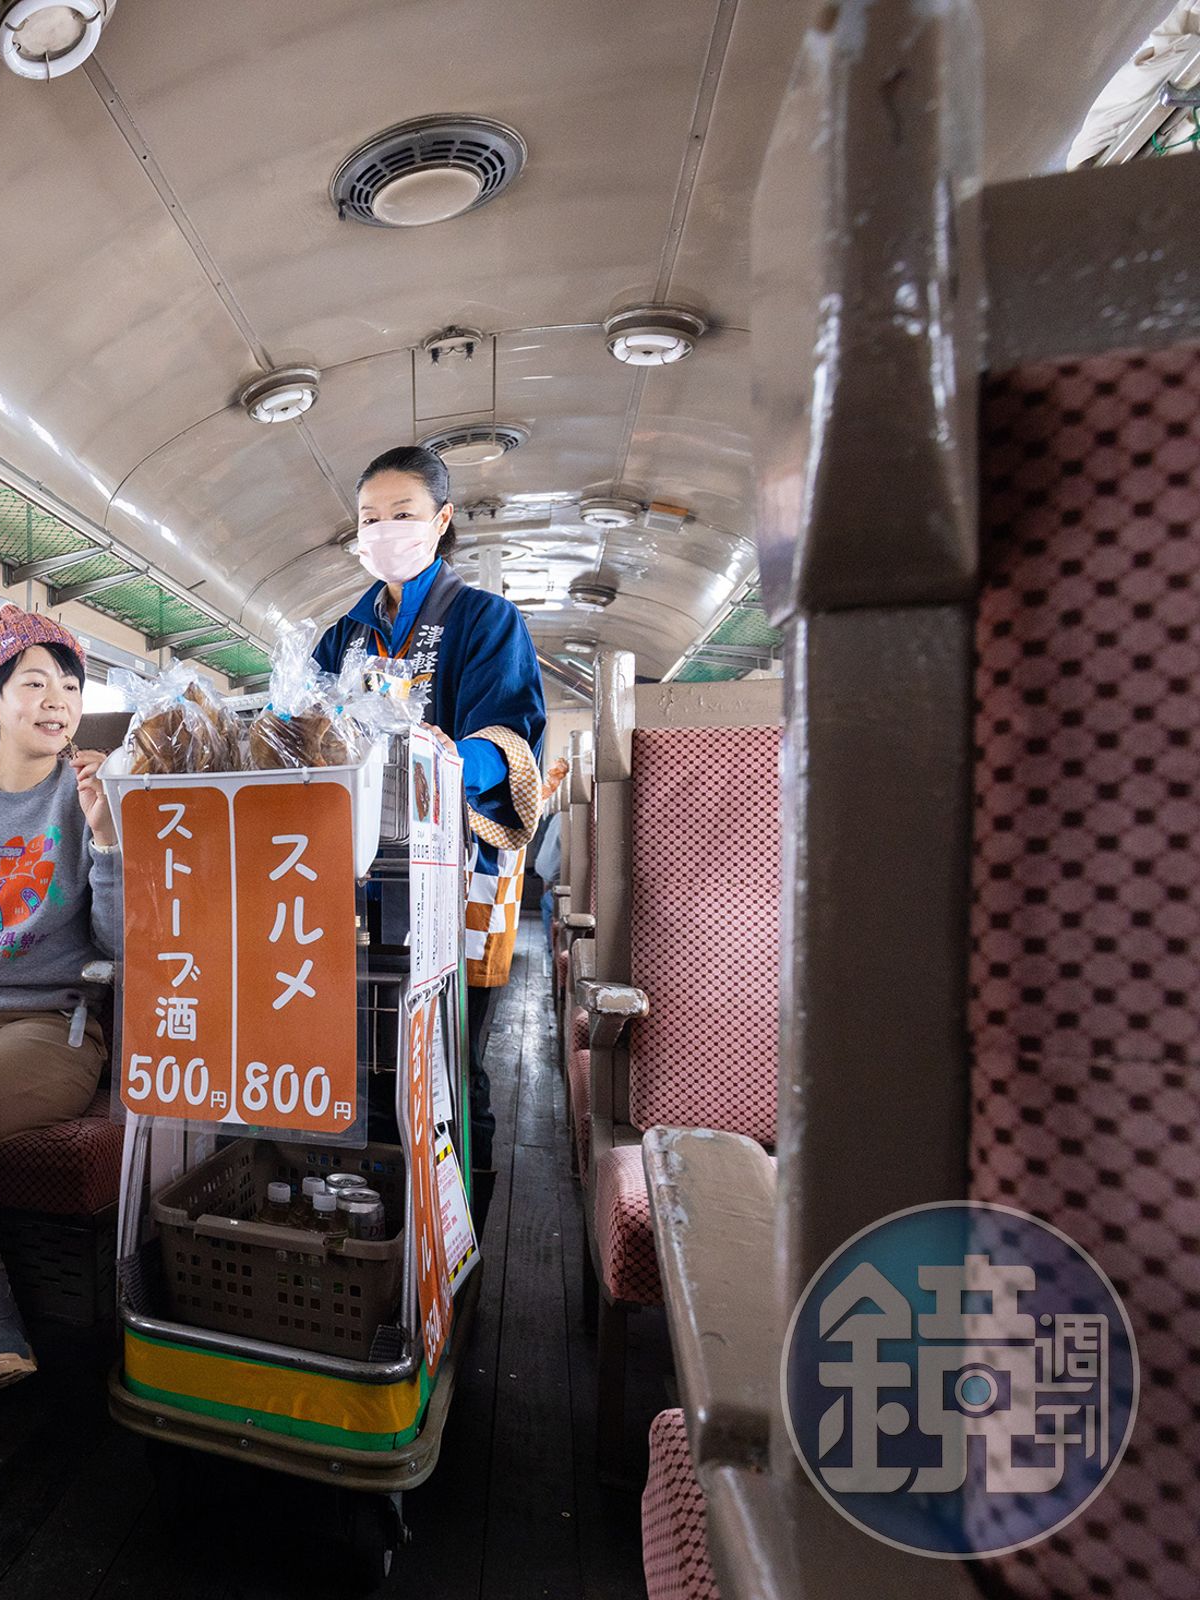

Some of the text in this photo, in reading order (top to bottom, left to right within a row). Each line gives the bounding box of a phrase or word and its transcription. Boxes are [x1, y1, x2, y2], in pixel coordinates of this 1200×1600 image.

[155, 803, 201, 1042] ストーブ酒
[269, 834, 324, 1010] スルメ
[127, 1053, 227, 1109] 500円
[242, 1061, 351, 1121] 800円
